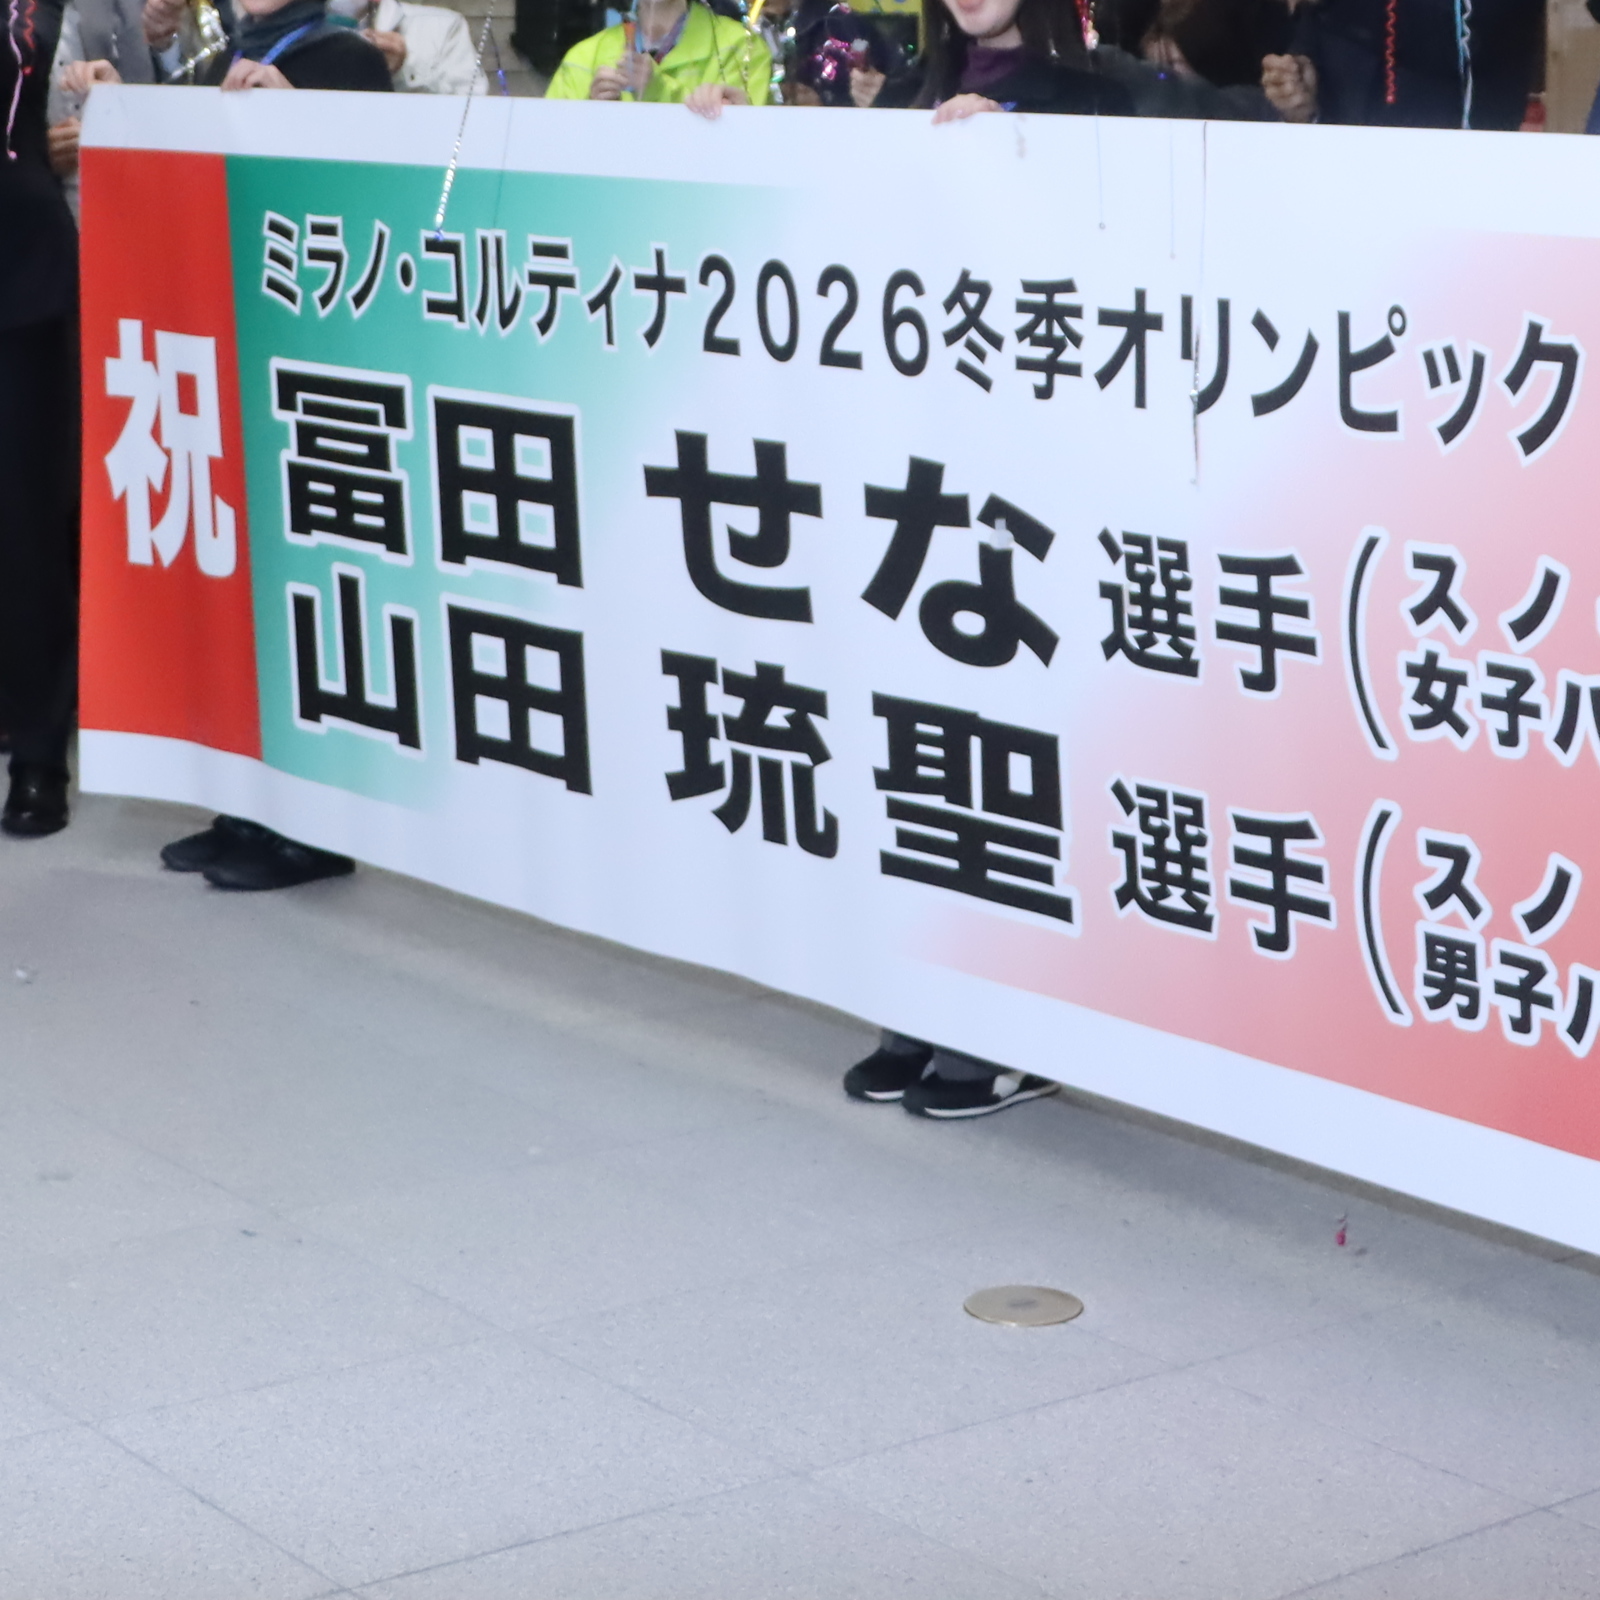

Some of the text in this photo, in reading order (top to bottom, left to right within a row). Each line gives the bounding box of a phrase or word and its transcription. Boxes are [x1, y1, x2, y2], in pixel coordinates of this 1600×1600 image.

[104, 317, 237, 579] 祝
[263, 213, 1583, 458] ミラノ・コルティナ2026冬季オリンピック
[276, 367, 586, 590] 冨田
[291, 571, 594, 797] 山田
